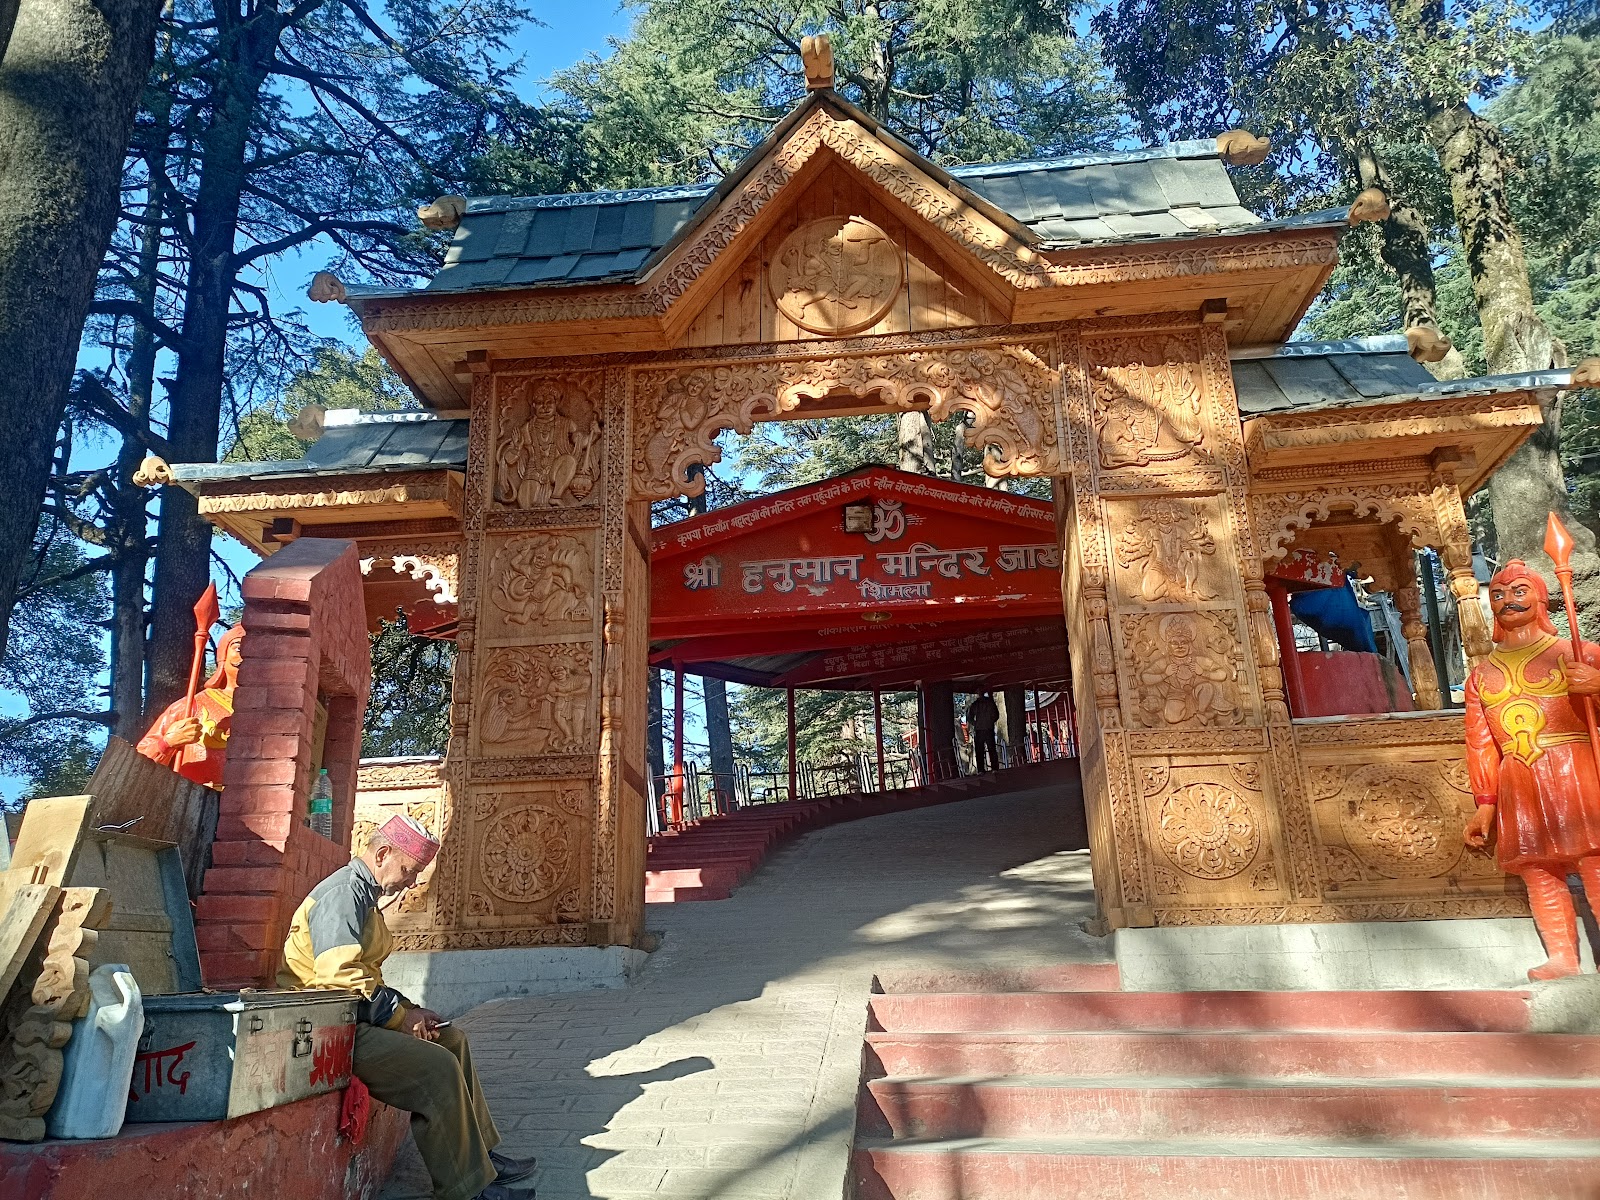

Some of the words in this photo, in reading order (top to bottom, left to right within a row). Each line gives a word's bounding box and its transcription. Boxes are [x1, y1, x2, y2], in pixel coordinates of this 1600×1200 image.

[677, 528, 702, 548] कृपया
[771, 499, 795, 515] मन्दिर
[796, 493, 812, 508] तक
[841, 482, 851, 494] के
[851, 476, 871, 491] लिए
[895, 479, 916, 494] चेयर
[912, 483, 927, 497] की
[959, 491, 970, 504] के
[991, 498, 1018, 515] मन्दिर
[1016, 503, 1046, 520] परिसर
[683, 554, 723, 590] श्री
[738, 553, 865, 594] हनुमान
[876, 541, 992, 580] मन्दिर
[855, 577, 932, 601] शिमला
